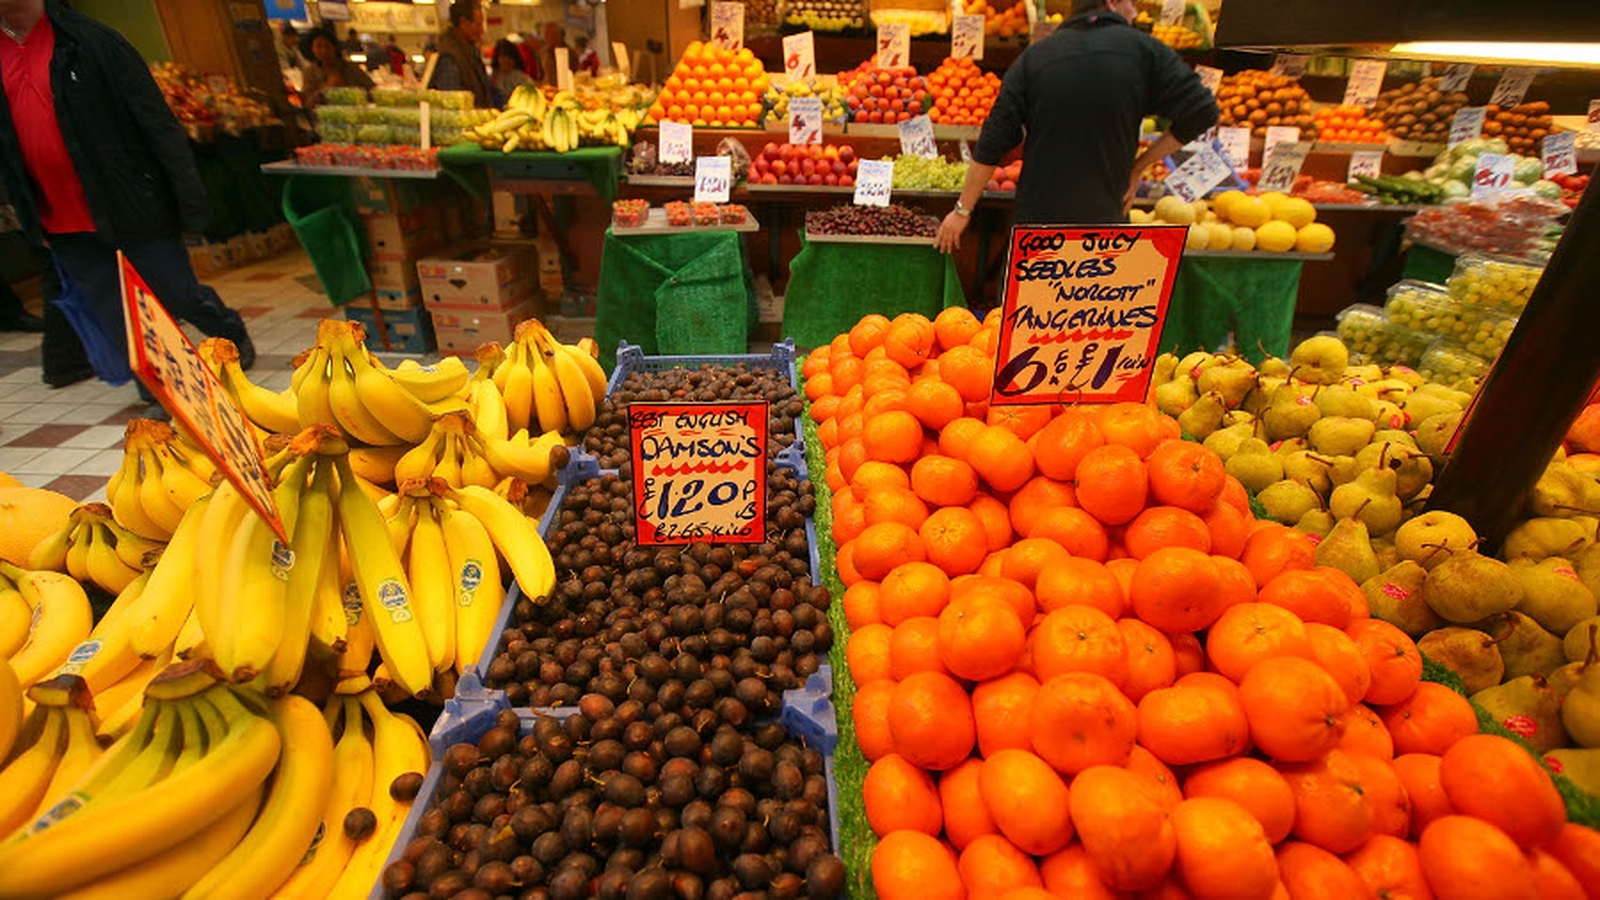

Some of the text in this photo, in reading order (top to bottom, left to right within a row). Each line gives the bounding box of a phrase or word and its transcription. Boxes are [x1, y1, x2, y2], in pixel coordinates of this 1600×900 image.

[1015, 257, 1118, 282] SEEDLESS
[1007, 304, 1160, 332] TANGERINES
[994, 345, 1048, 397] 6
[675, 410, 749, 429] ENGLISH
[640, 434, 762, 461] DAMSON'S
